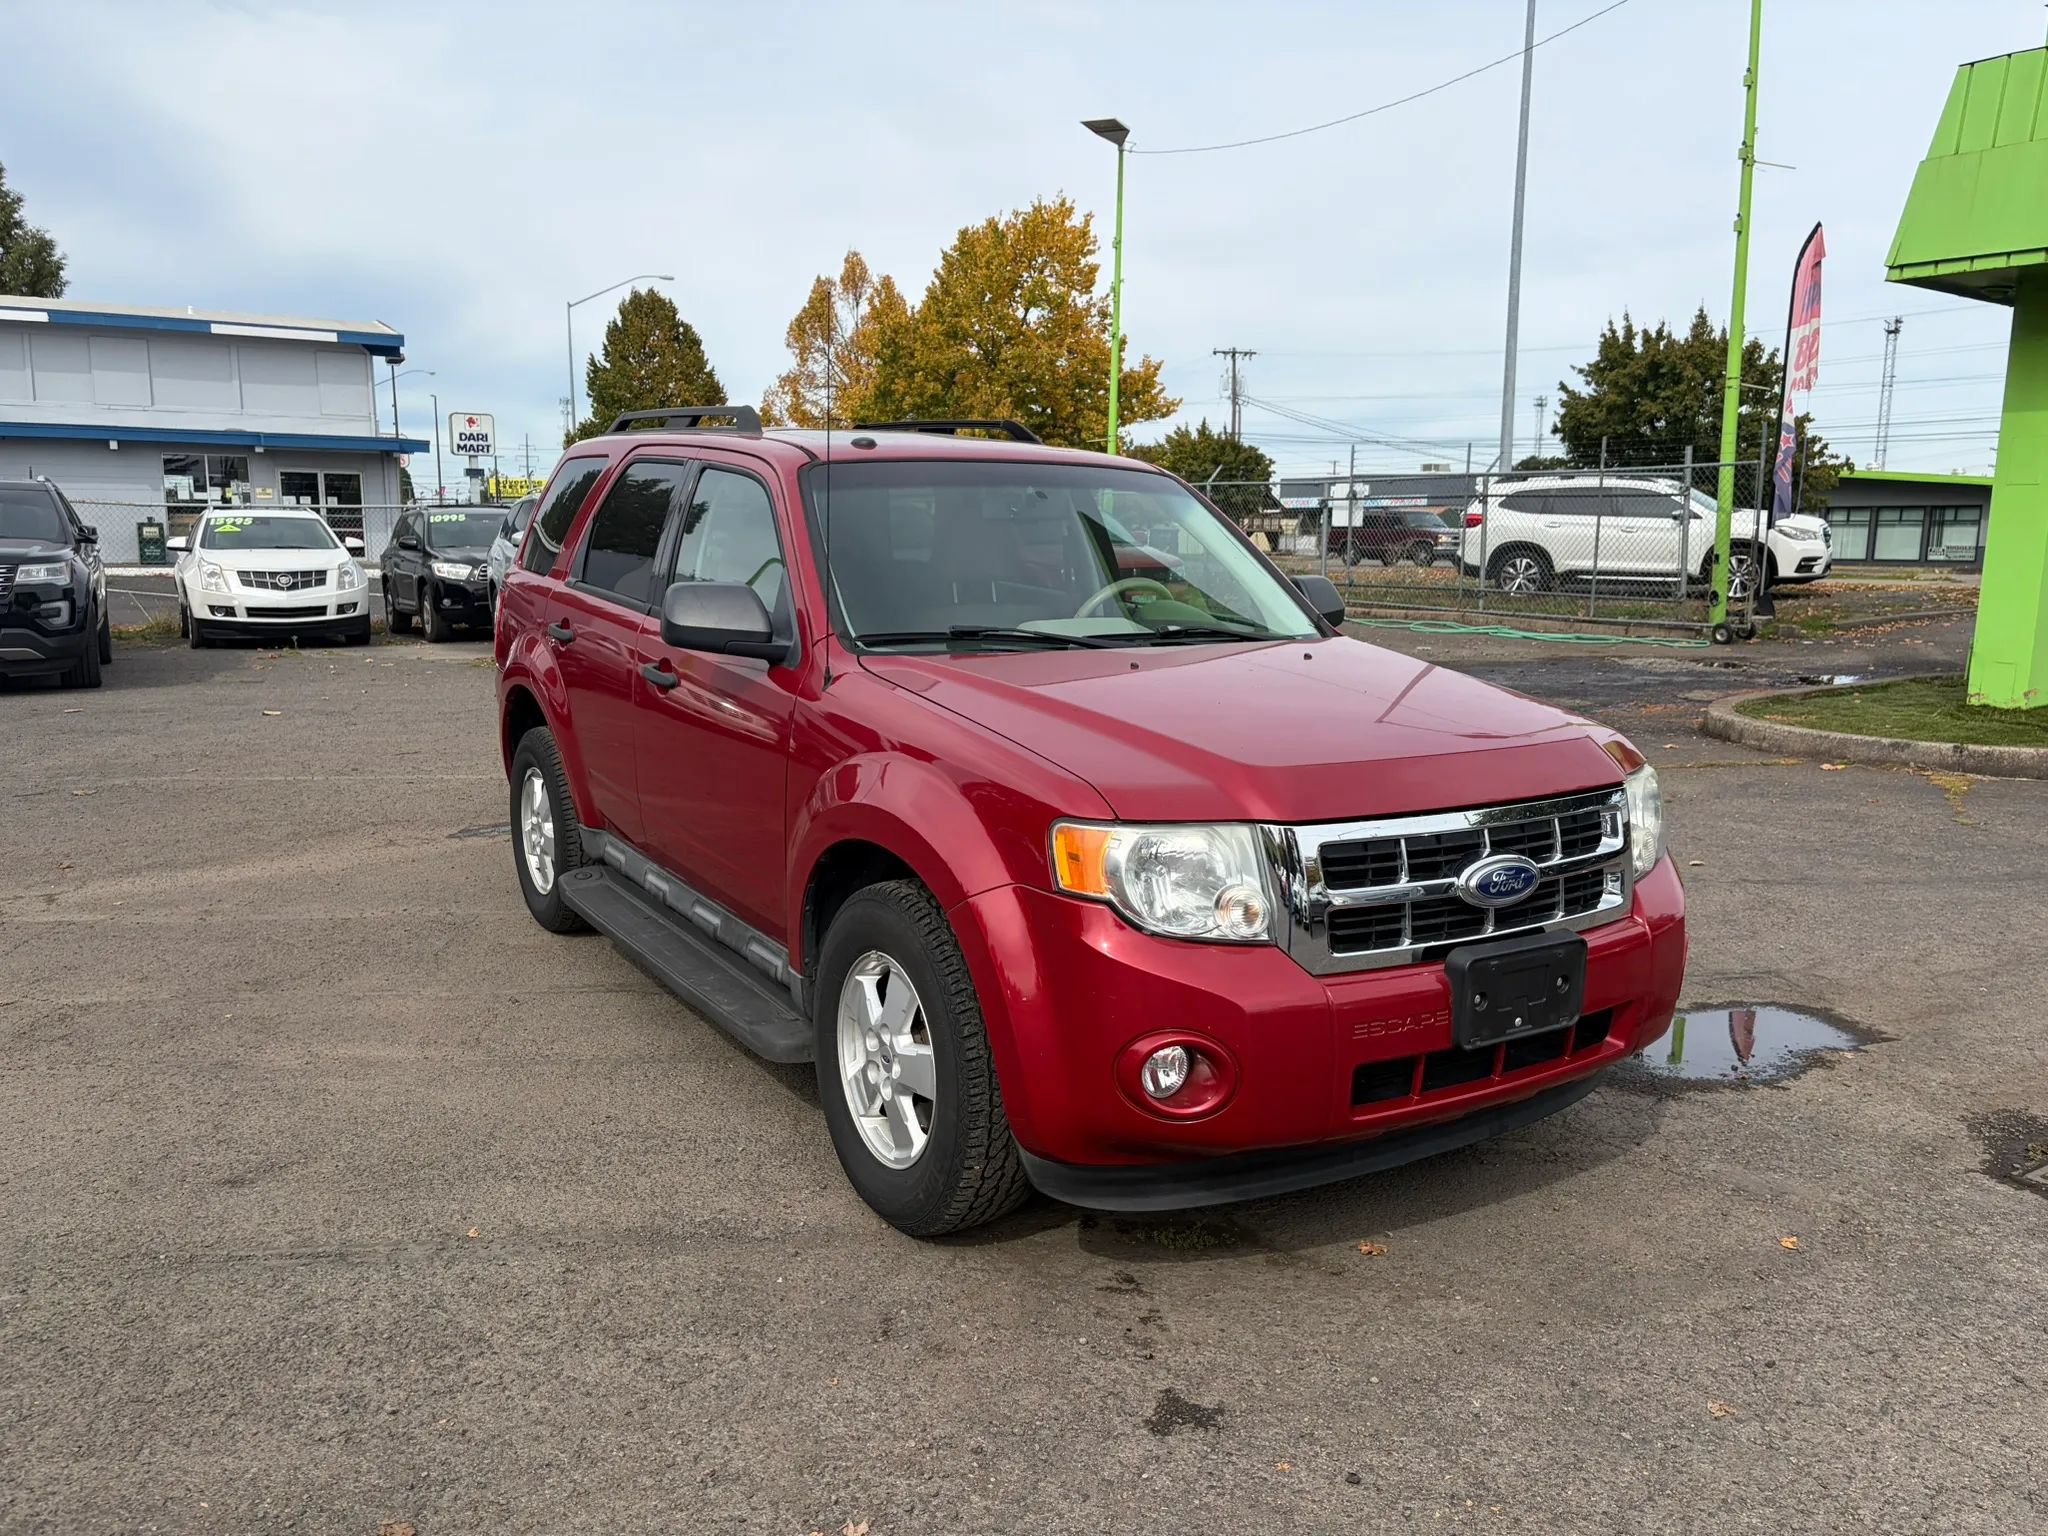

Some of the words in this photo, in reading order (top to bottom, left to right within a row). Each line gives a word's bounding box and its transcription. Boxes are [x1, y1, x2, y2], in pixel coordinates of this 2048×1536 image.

[459, 432, 489, 442] DARI
[456, 443, 492, 453] MART
[429, 513, 466, 523] 10995
[1489, 869, 1526, 894] Ford
[1352, 1010, 1449, 1039] ESCAPE
